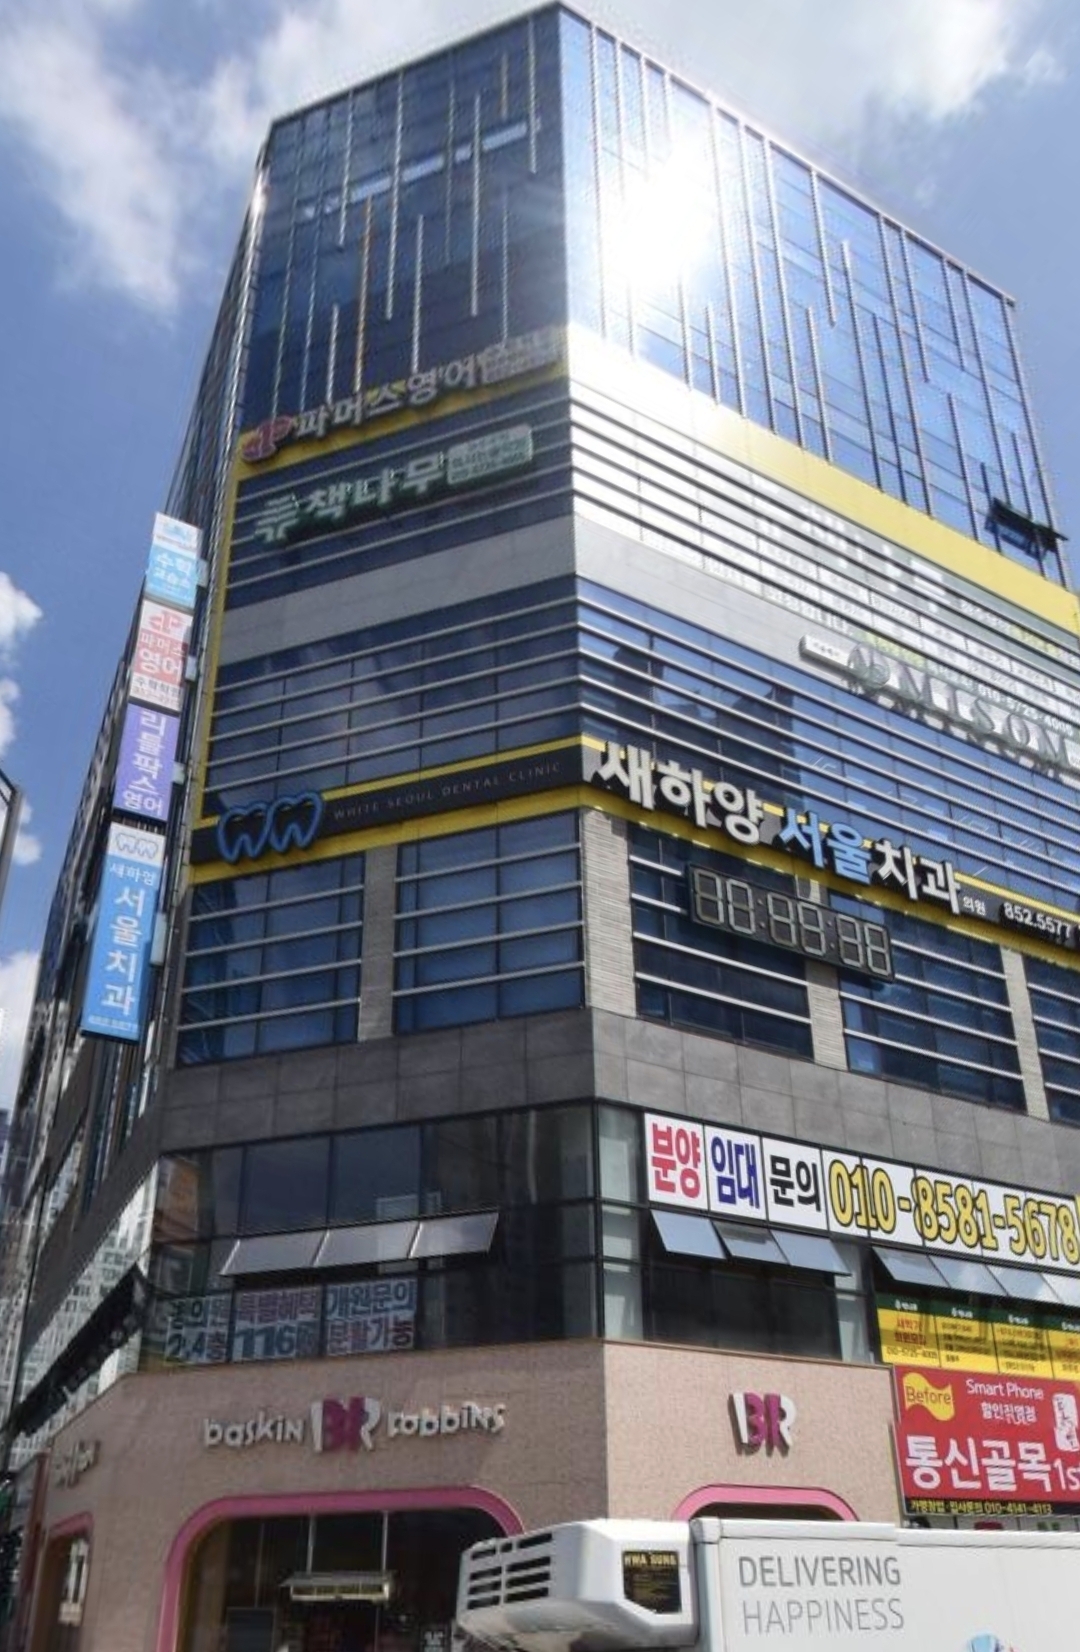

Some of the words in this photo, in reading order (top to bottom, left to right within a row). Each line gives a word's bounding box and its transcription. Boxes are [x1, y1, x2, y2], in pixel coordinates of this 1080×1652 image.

[293, 352, 477, 438] 파머스영어
[306, 450, 446, 520] 책나무
[138, 647, 183, 687] 영어
[333, 801, 380, 821] WHITE
[388, 790, 434, 810] SEOUL
[441, 776, 499, 796] DENTAL
[508, 761, 562, 784] CLINIC
[600, 741, 765, 845] 새하양
[778, 807, 961, 915] 서울치과
[1003, 902, 1072, 938] 852.5577
[101, 886, 147, 1017] 서울치과
[652, 1122, 701, 1199] 분양
[710, 1136, 760, 1210] 임대
[769, 1153, 821, 1212] 문의
[828, 1159, 1080, 1266] 010-8581-5678
[905, 1384, 952, 1405] Before
[965, 1378, 1004, 1396] Smart
[1006, 1382, 1045, 1401] Phone
[311, 1396, 382, 1453] BR
[729, 1391, 797, 1454] BR
[905, 1434, 1052, 1493] 통신골목
[738, 1555, 901, 1588] DELIVERING
[743, 1598, 905, 1635] HAPPINESS
